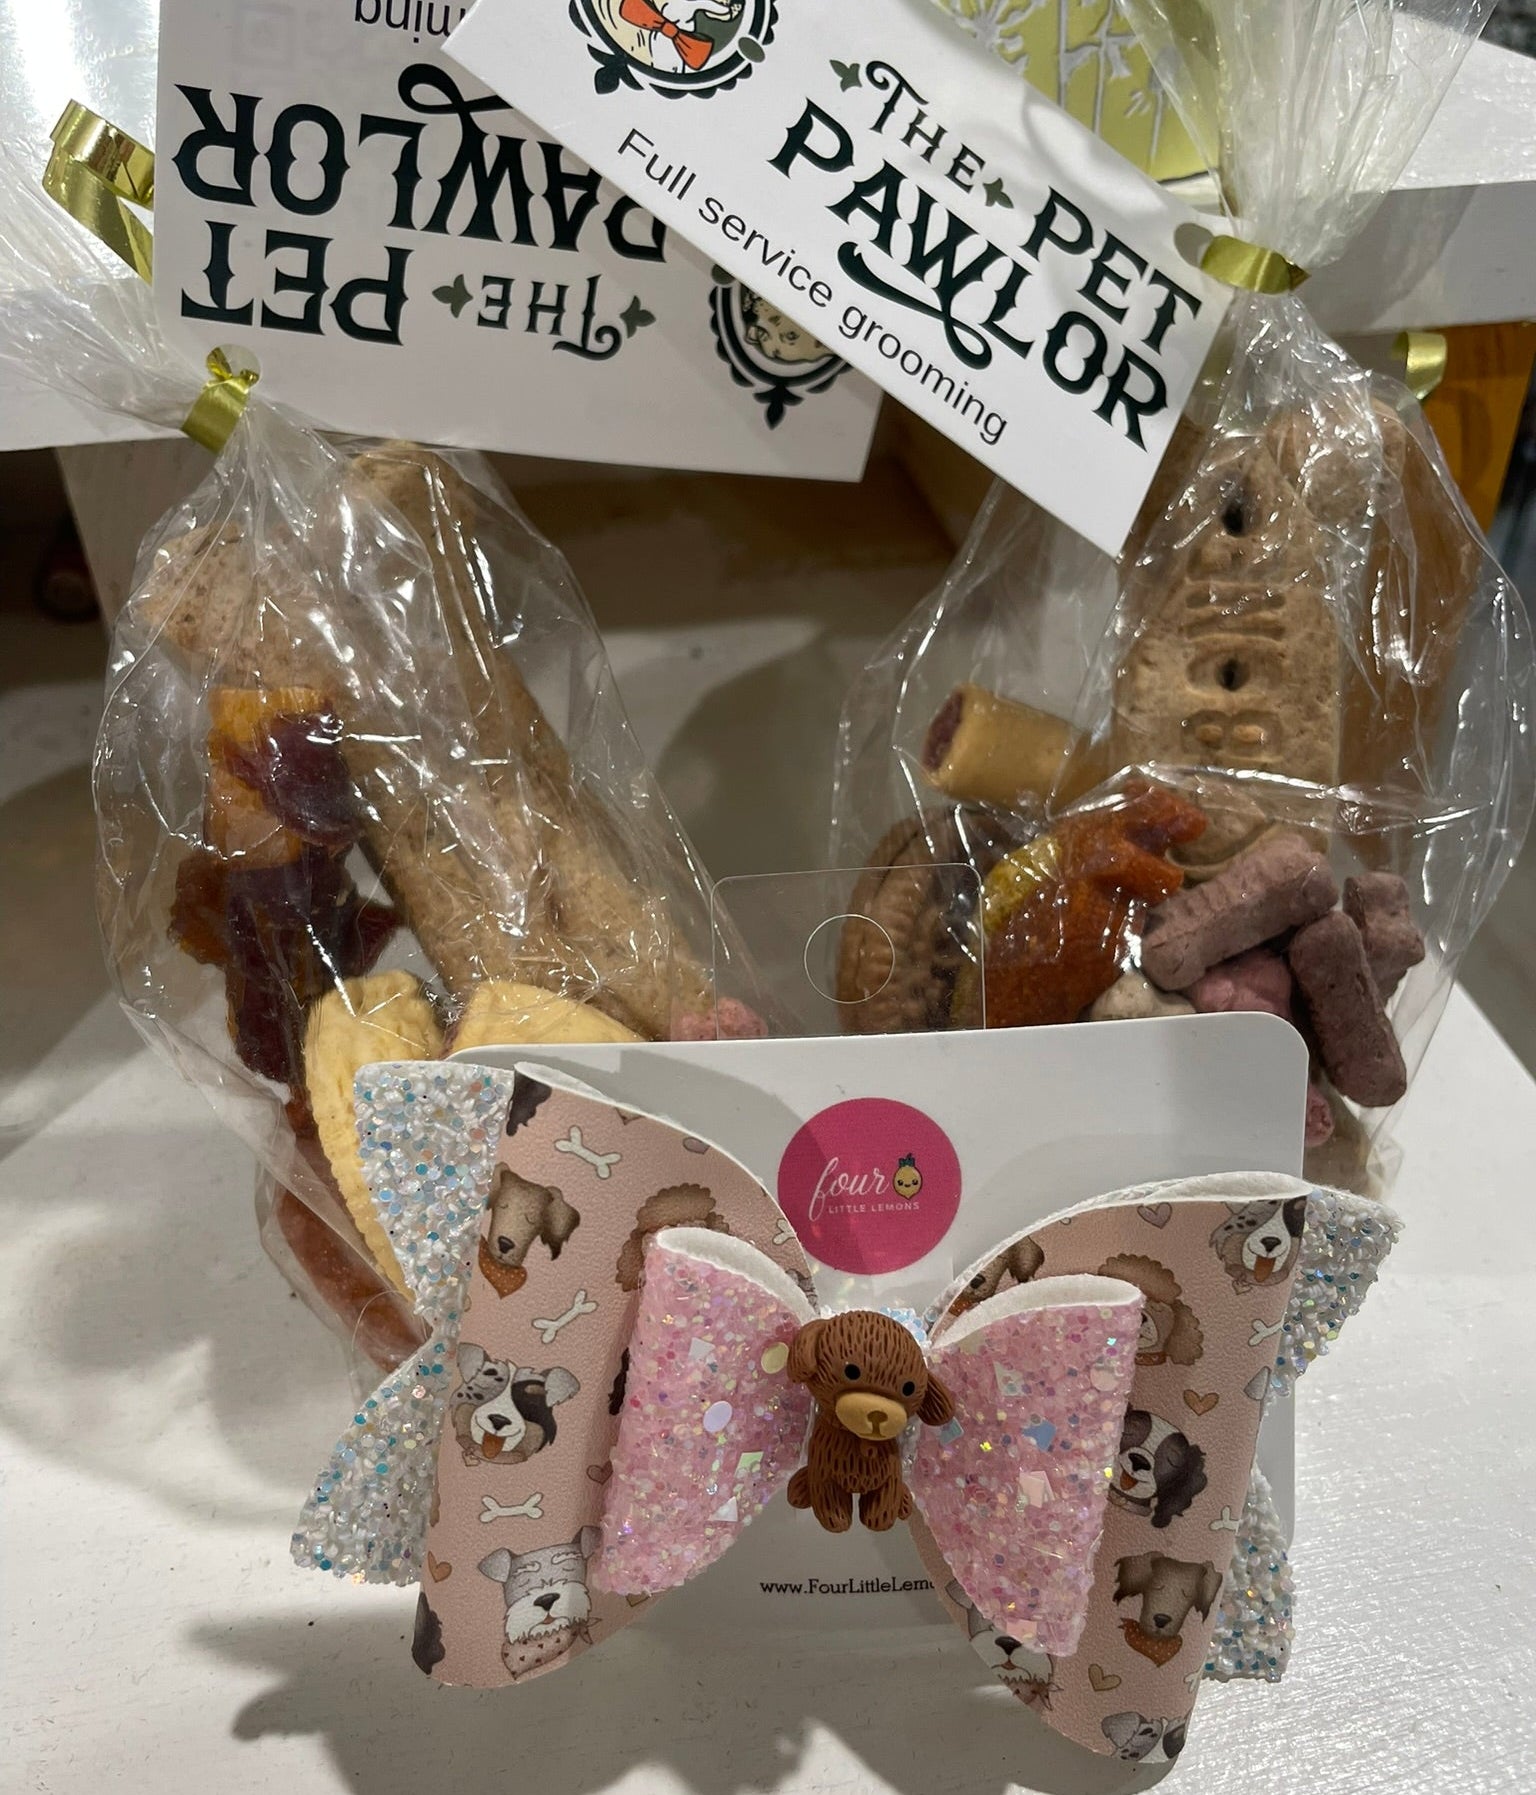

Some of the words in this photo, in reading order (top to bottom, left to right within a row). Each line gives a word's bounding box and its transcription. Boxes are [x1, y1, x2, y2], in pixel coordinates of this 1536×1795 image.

[171, 63, 666, 263] PAWLOR
[866, 61, 985, 193] THE
[1019, 186, 1202, 357] PET
[181, 220, 414, 346] PET
[479, 274, 622, 361] THE
[617, 128, 697, 201] Full
[698, 197, 834, 308] service
[839, 305, 1008, 446] grooming
[768, 97, 1169, 452] PAWLOR
[809, 1156, 890, 1222] four
[829, 1204, 866, 1214] LITTLE
[871, 1201, 921, 1212] LEMONS
